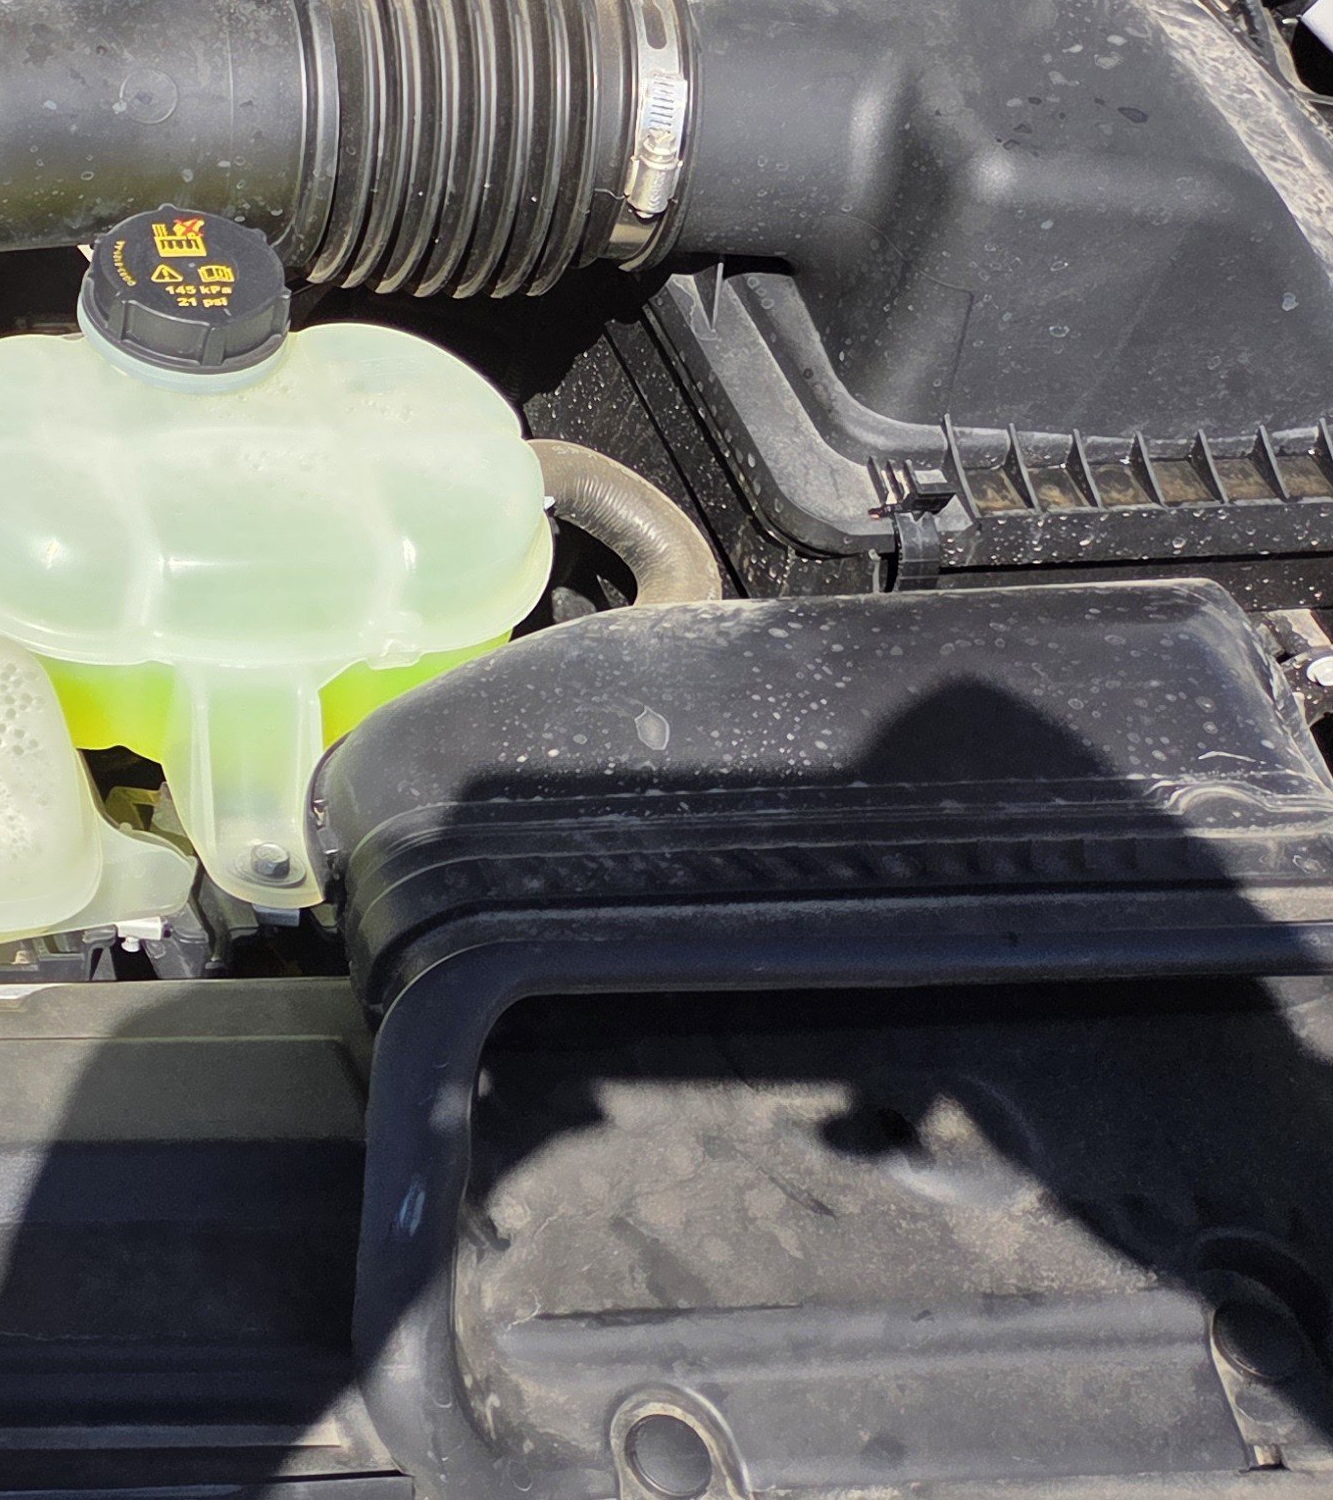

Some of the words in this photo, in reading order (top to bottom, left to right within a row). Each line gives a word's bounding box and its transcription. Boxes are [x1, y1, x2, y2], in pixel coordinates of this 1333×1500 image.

[165, 285, 196, 295] 145
[200, 285, 232, 295] kPa
[176, 297, 198, 307] 21
[202, 297, 229, 308] psi
